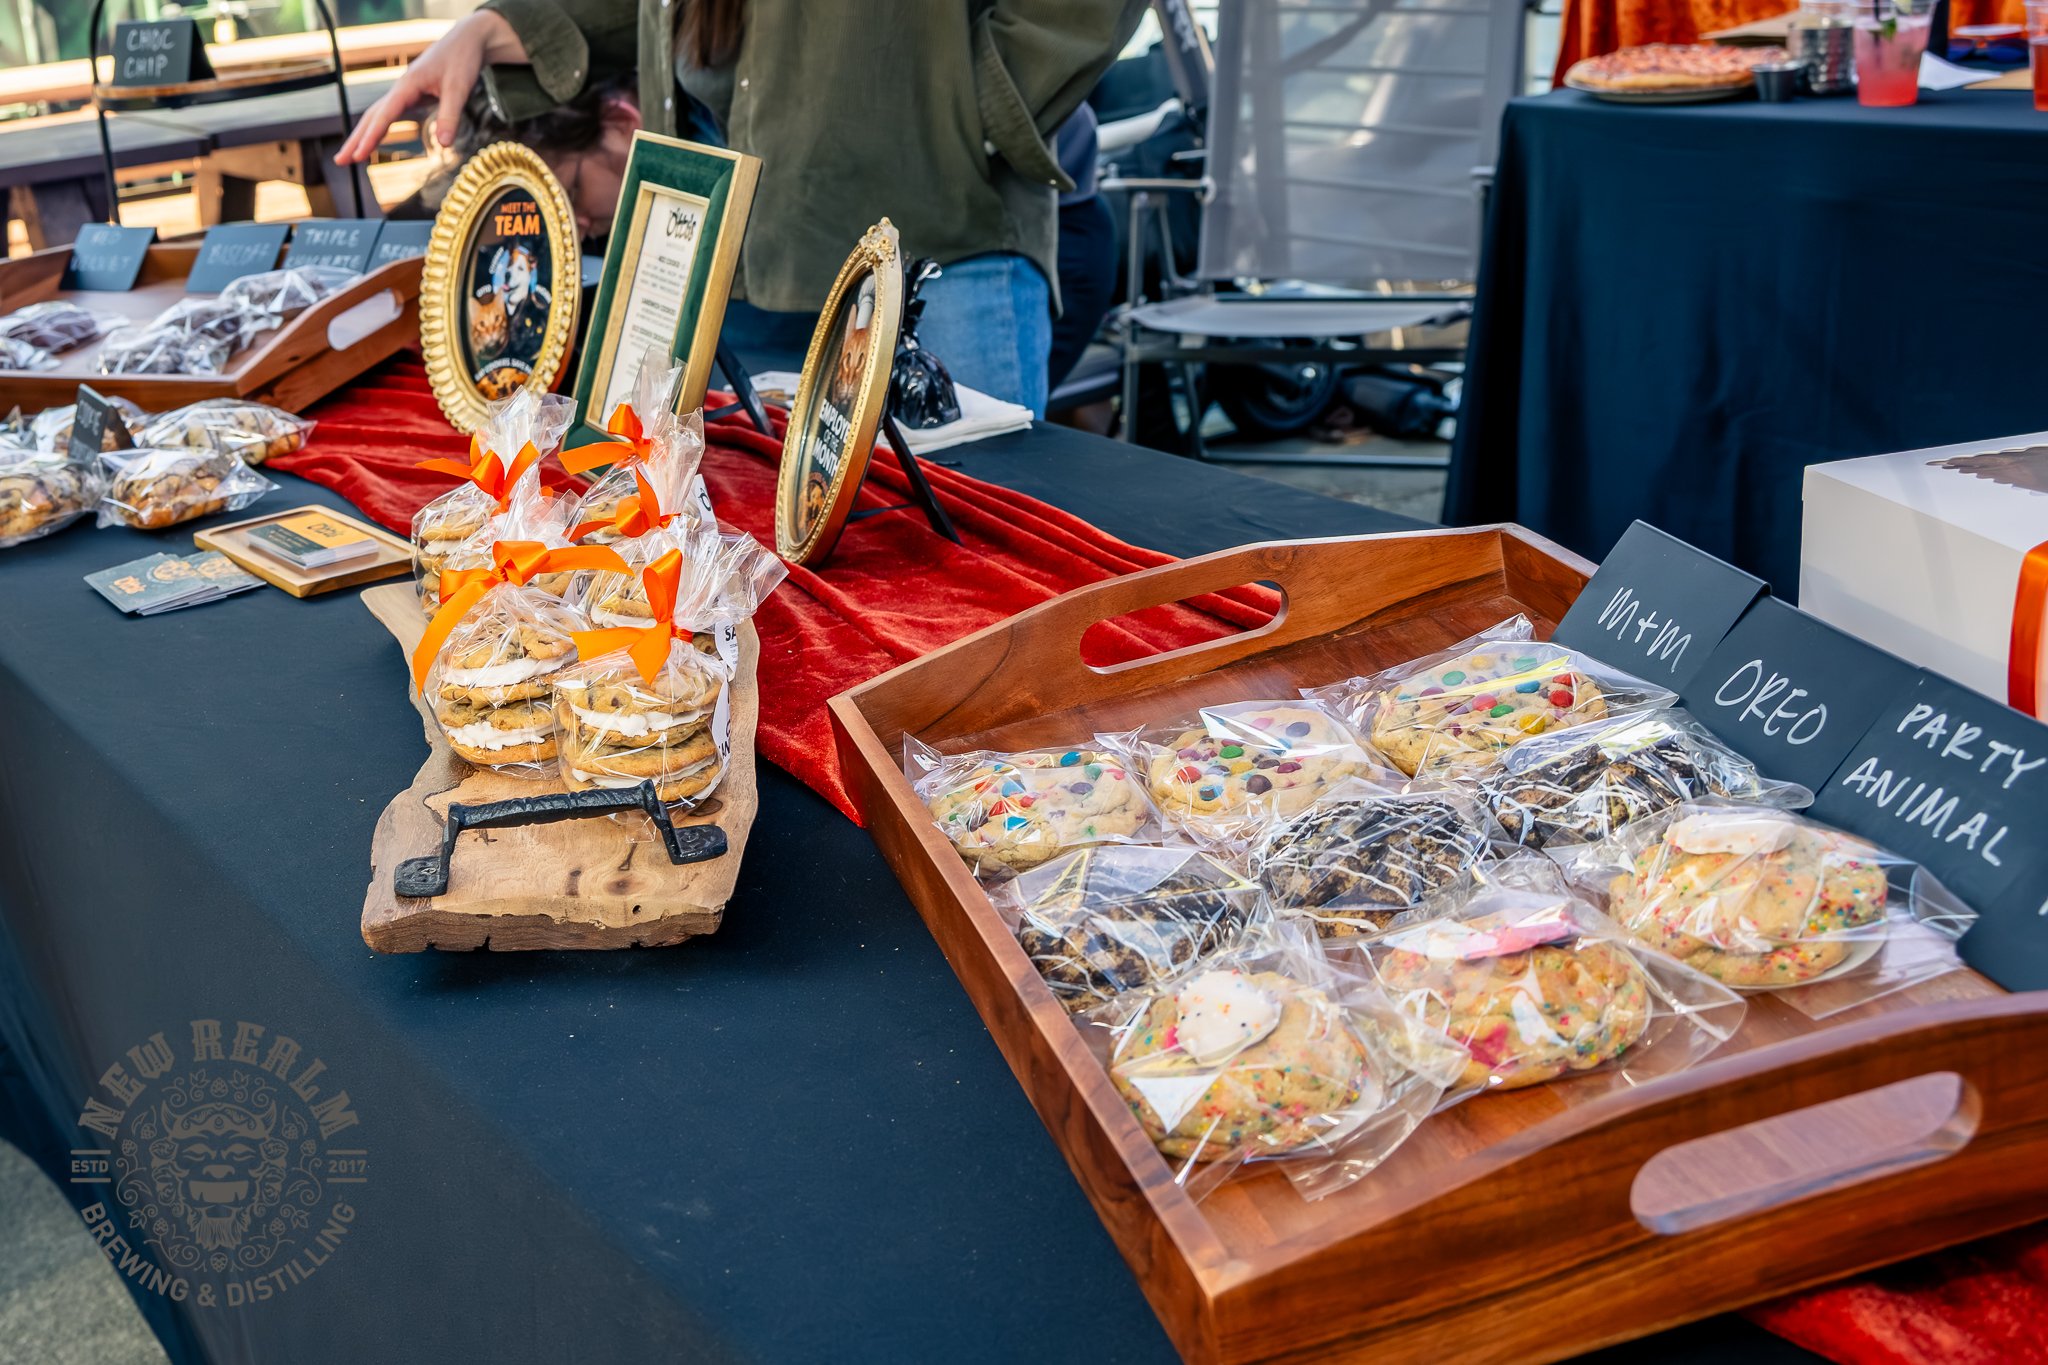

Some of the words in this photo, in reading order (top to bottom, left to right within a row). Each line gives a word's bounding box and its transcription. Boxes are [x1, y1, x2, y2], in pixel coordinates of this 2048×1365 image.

[126, 28, 175, 52] CHOC
[123, 53, 168, 79] CHIP
[501, 203, 521, 213] MEET
[522, 202, 536, 212] THE
[304, 228, 361, 248] TRIPLE
[495, 214, 541, 236] TEAM
[812, 437, 840, 477] MONTH
[1597, 586, 1692, 673] M+M
[1714, 659, 1827, 745] OREO
[1896, 702, 2047, 790] PARTY
[1842, 757, 2009, 867] ANIMAL
